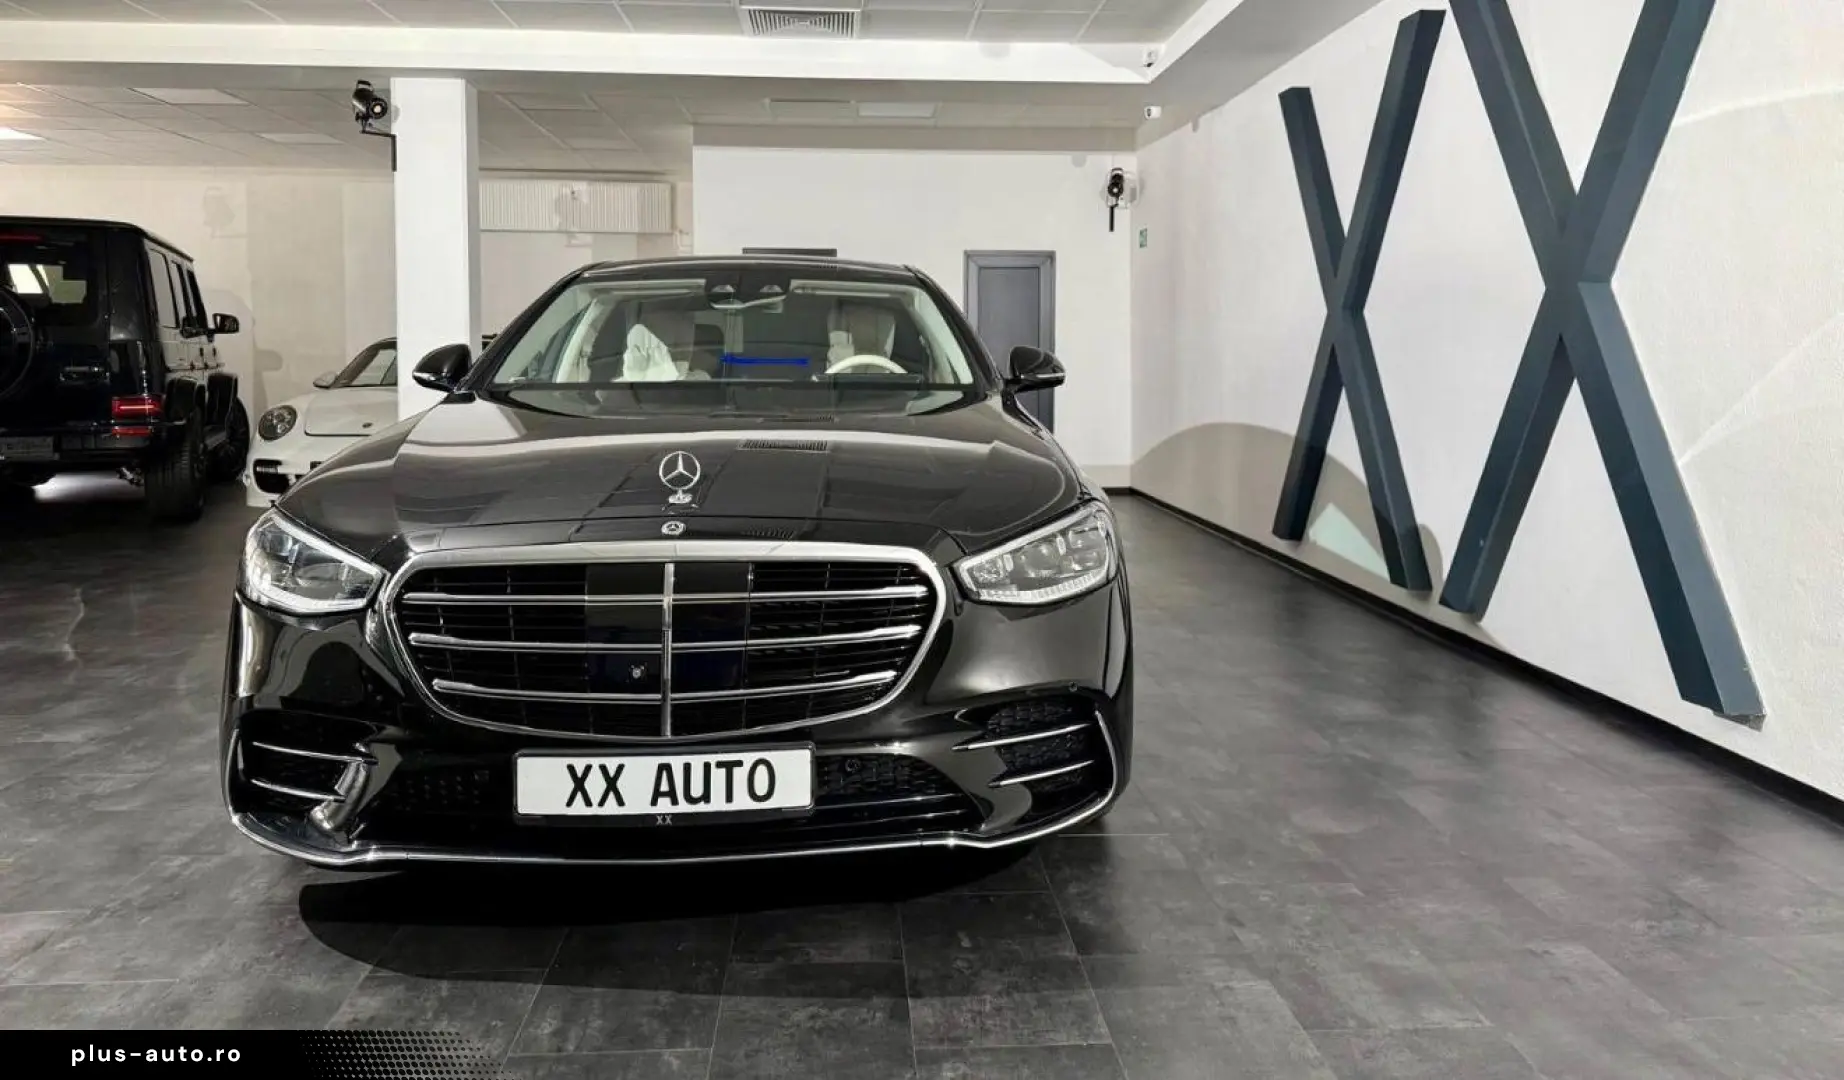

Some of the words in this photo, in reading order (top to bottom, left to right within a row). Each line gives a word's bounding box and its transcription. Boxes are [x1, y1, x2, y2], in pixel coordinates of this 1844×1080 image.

[565, 763, 626, 808] XX
[650, 758, 776, 807] AUTO
[656, 815, 673, 826] XX
